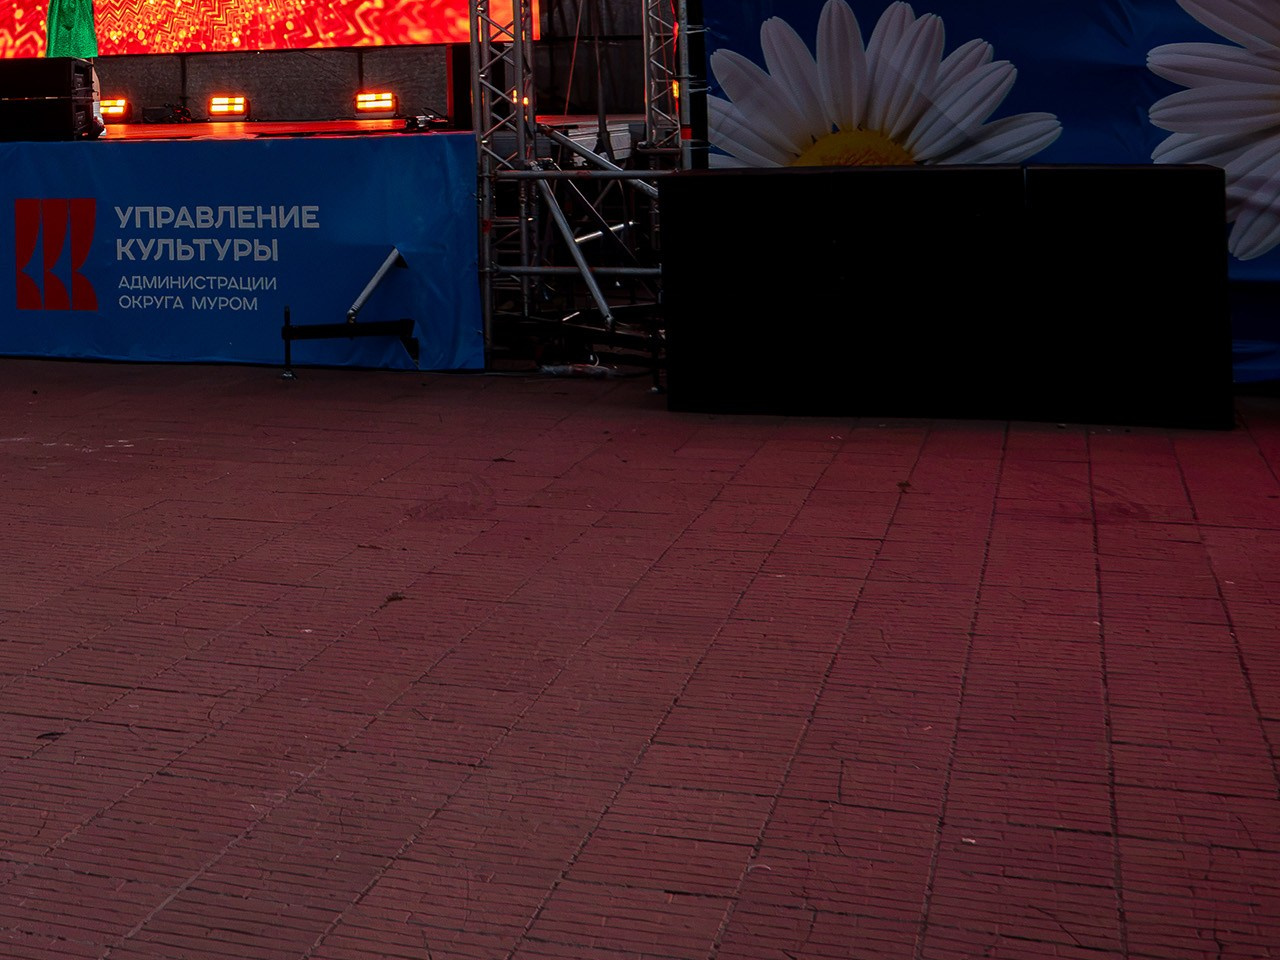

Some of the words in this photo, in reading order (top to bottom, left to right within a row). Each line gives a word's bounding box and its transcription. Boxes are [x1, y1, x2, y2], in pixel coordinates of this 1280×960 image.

[114, 205, 320, 229] УПРАВЛЕНИЕ
[116, 238, 279, 262] КУЛЬТУРЫ
[118, 275, 277, 292] АДМИНИСТРАЦИИ
[118, 295, 185, 310] ОКРУГА
[191, 296, 258, 311] МУРОМ
